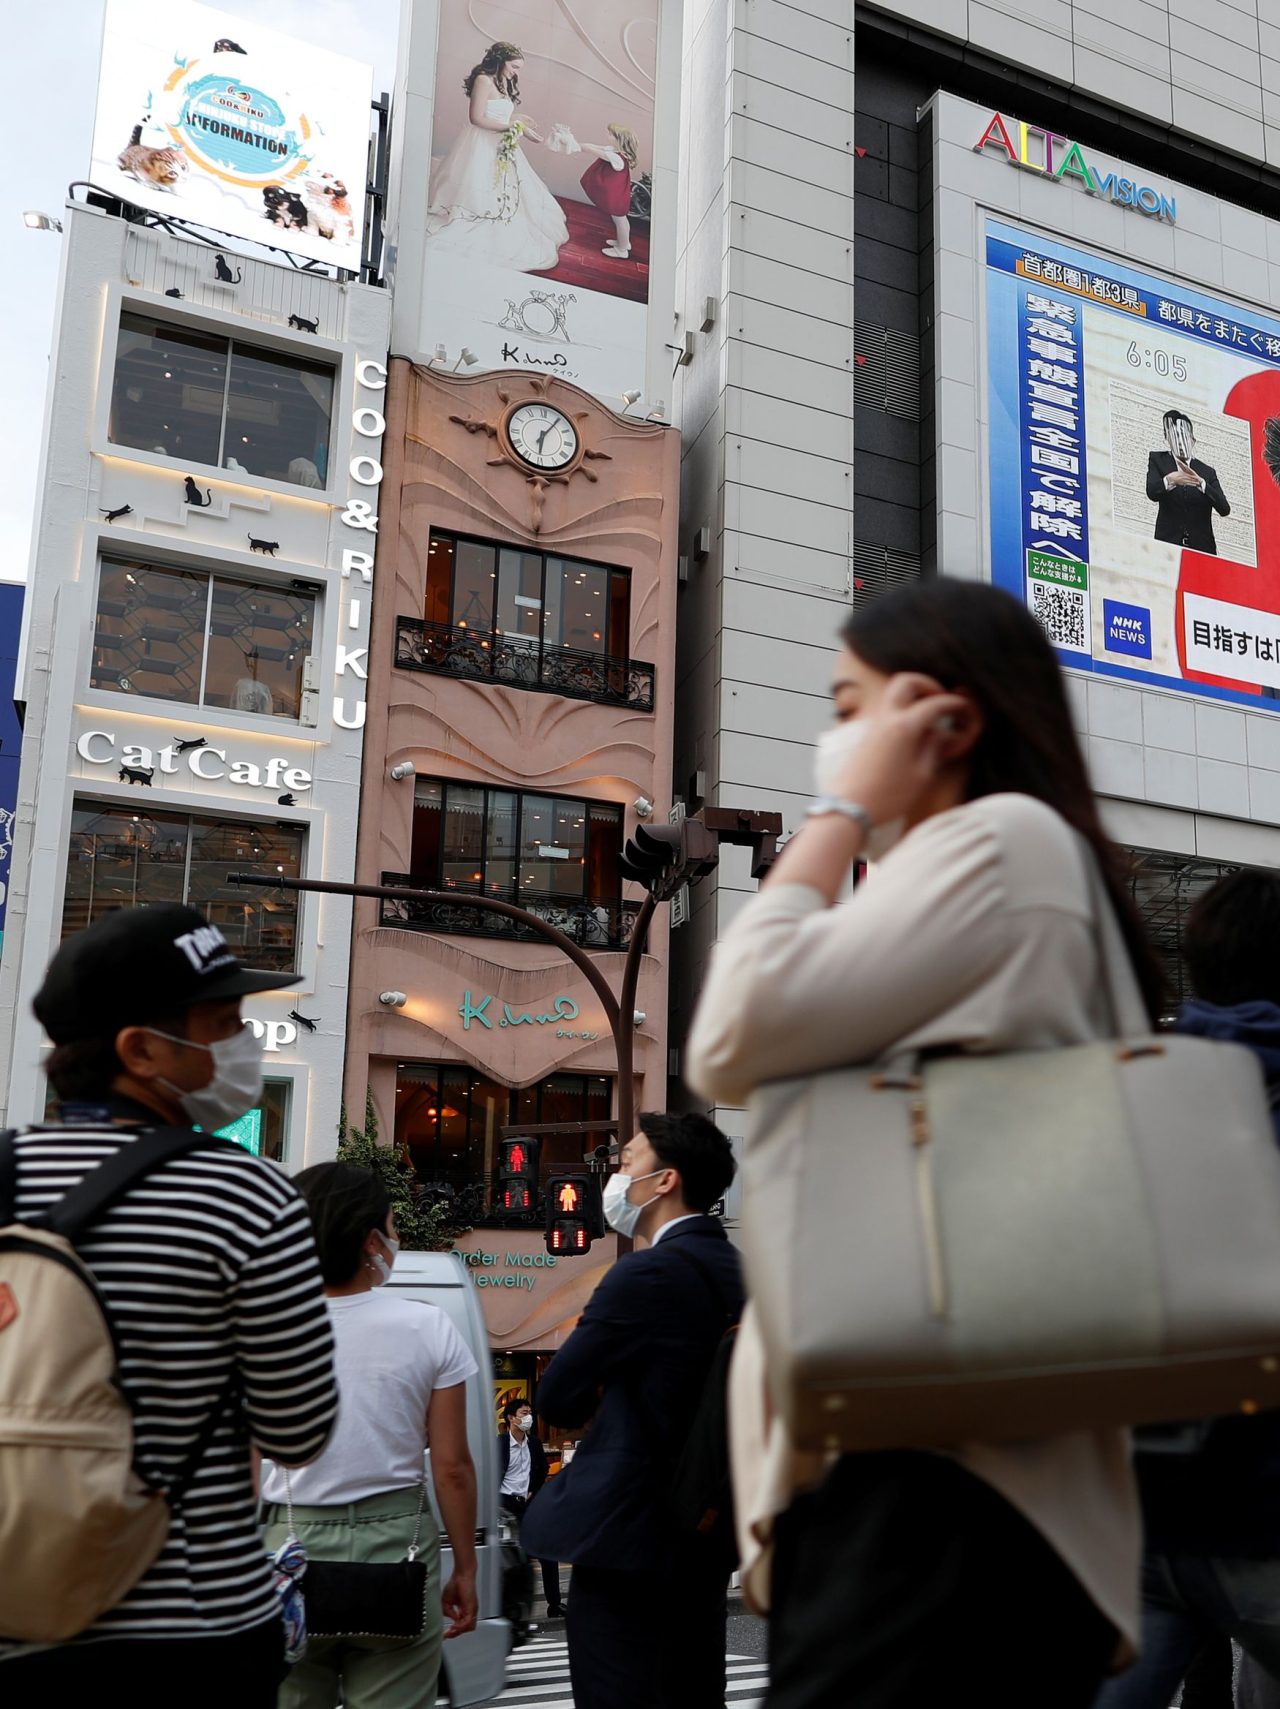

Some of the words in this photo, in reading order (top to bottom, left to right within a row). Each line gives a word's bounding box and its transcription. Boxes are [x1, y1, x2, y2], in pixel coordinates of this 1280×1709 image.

[973, 111, 1097, 196] ALTA
[1090, 166, 1177, 224] VISION
[1022, 252, 1141, 311] 首都圏1都3県
[1126, 341, 1188, 382] 6:05
[1026, 292, 1084, 563] 緊急事態宣言全国で解除へ
[332, 359, 388, 730] COO&RIKU
[1109, 627, 1147, 646] NEWS
[1112, 614, 1142, 632] NHK
[77, 731, 181, 774] Cat
[188, 747, 313, 791] Cafe
[450, 1250, 499, 1267] Order
[505, 1250, 557, 1268] Made
